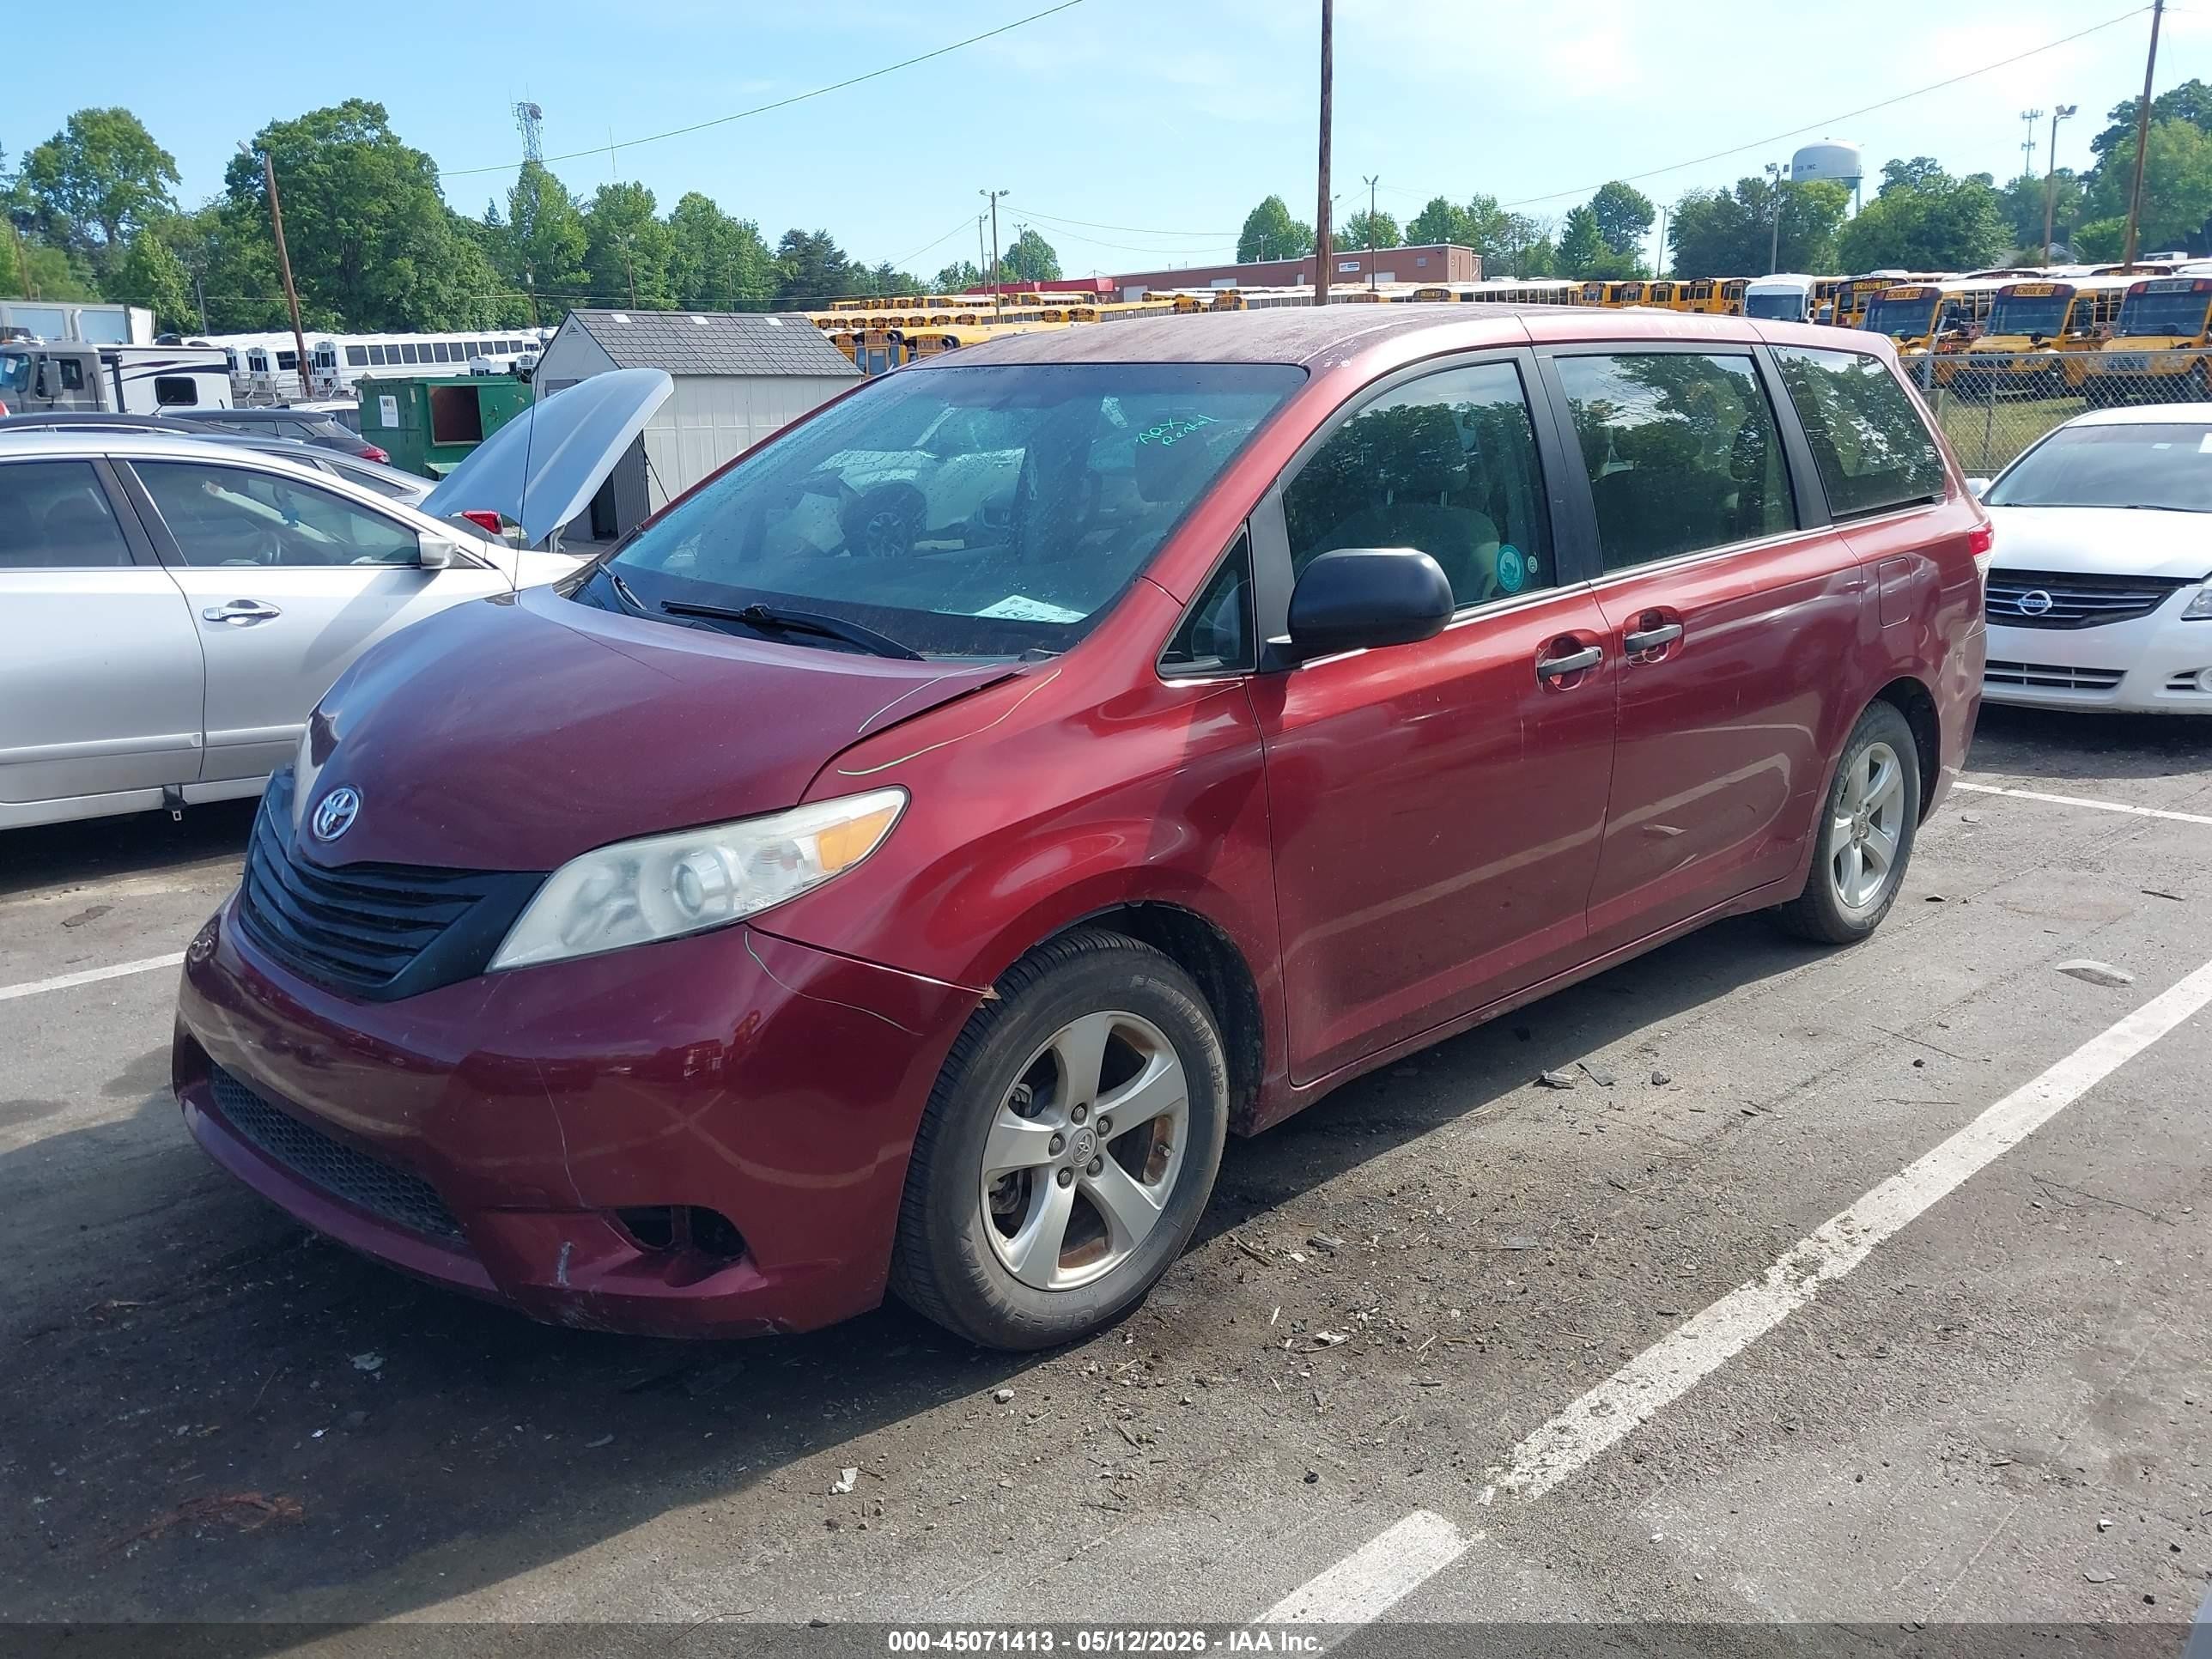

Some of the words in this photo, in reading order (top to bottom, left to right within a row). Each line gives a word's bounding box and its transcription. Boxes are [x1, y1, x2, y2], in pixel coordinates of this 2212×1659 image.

[1886, 290, 1906, 299] SCHOOL
[2014, 287, 2037, 295] SCHOOL
[2039, 286, 2053, 295] BUS
[1162, 414, 1219, 447] Rental
